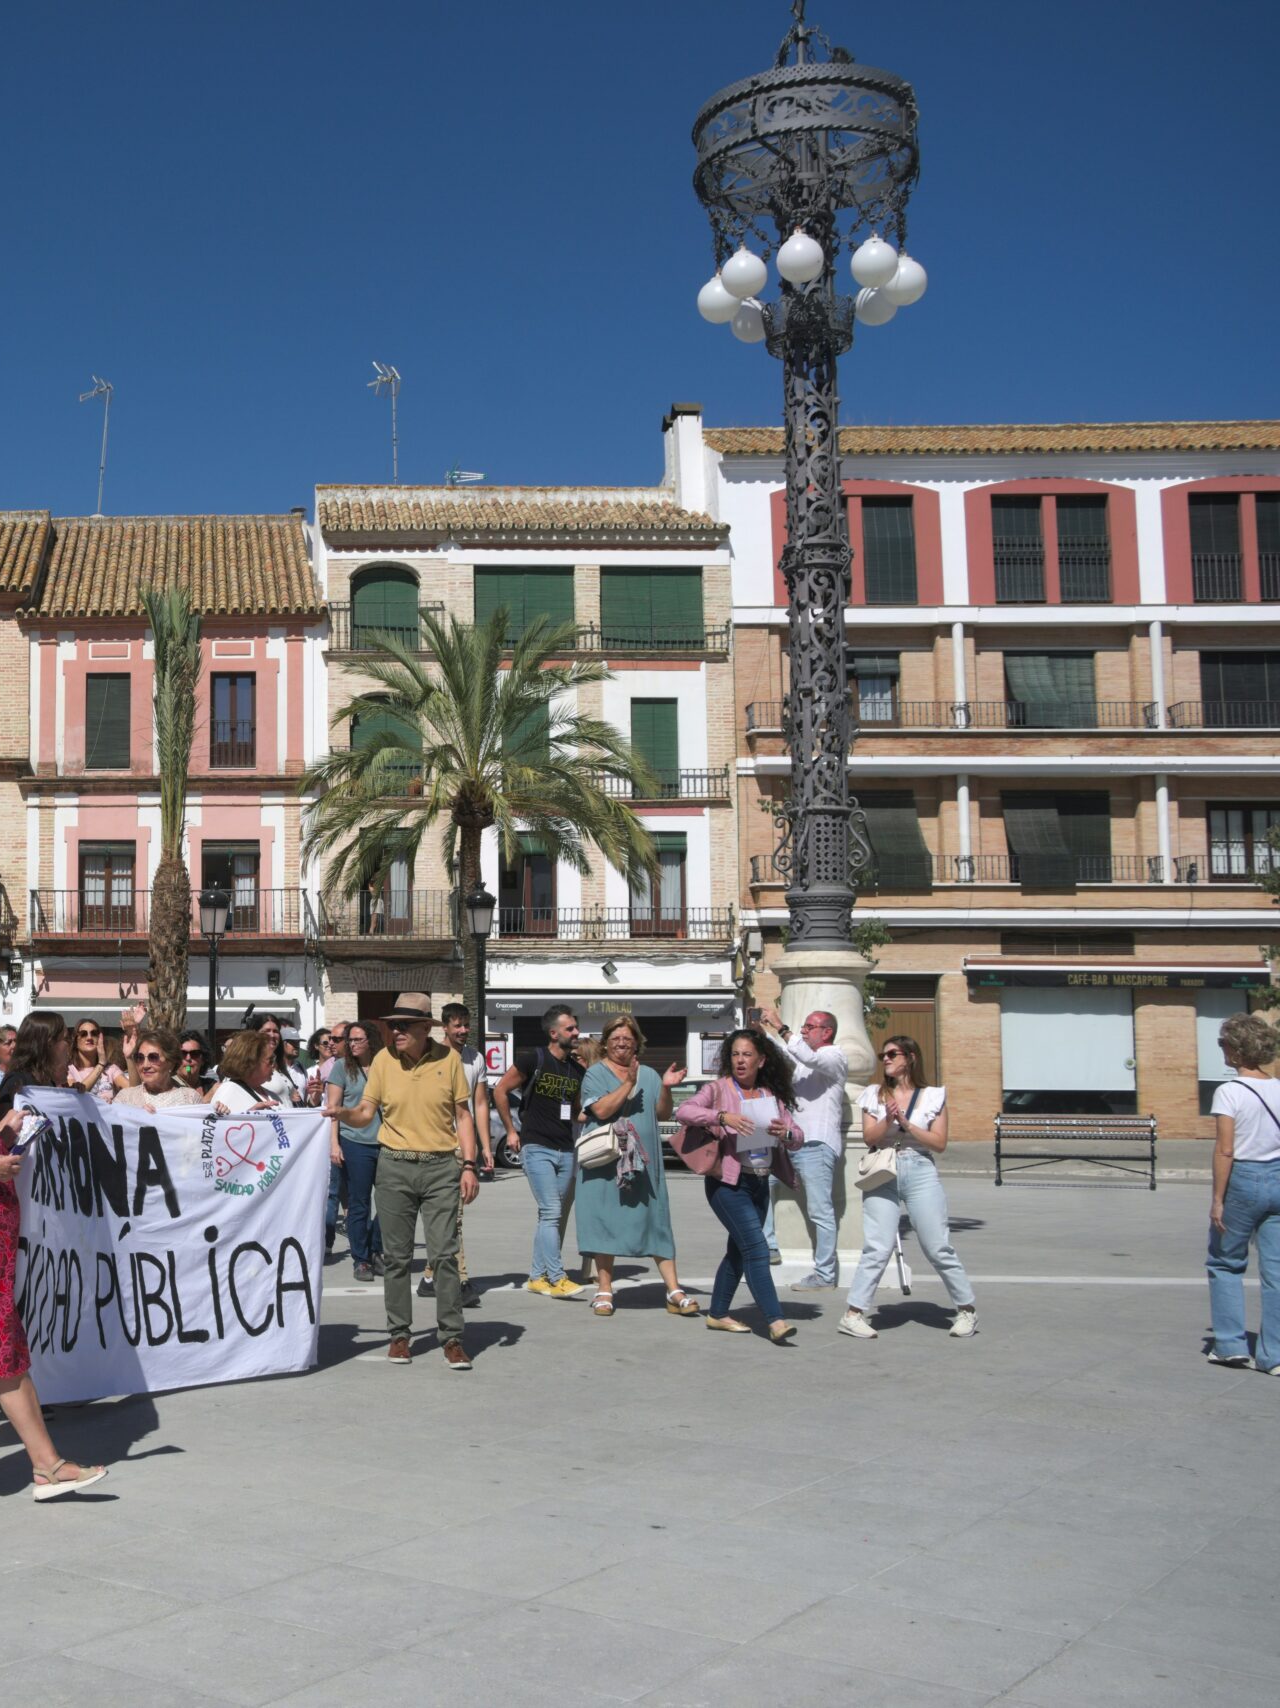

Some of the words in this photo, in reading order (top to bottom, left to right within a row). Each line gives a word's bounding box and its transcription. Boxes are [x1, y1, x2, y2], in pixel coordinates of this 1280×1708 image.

[1067, 973, 1108, 985] CAFÉ-BAR
[1112, 974, 1169, 987] MASCARPONE
[587, 1001, 598, 1013] EL
[214, 1178, 255, 1196] SANIDAD
[257, 1155, 284, 1192] PÚBLICA
[95, 1221, 316, 1350] PÚBLICA
